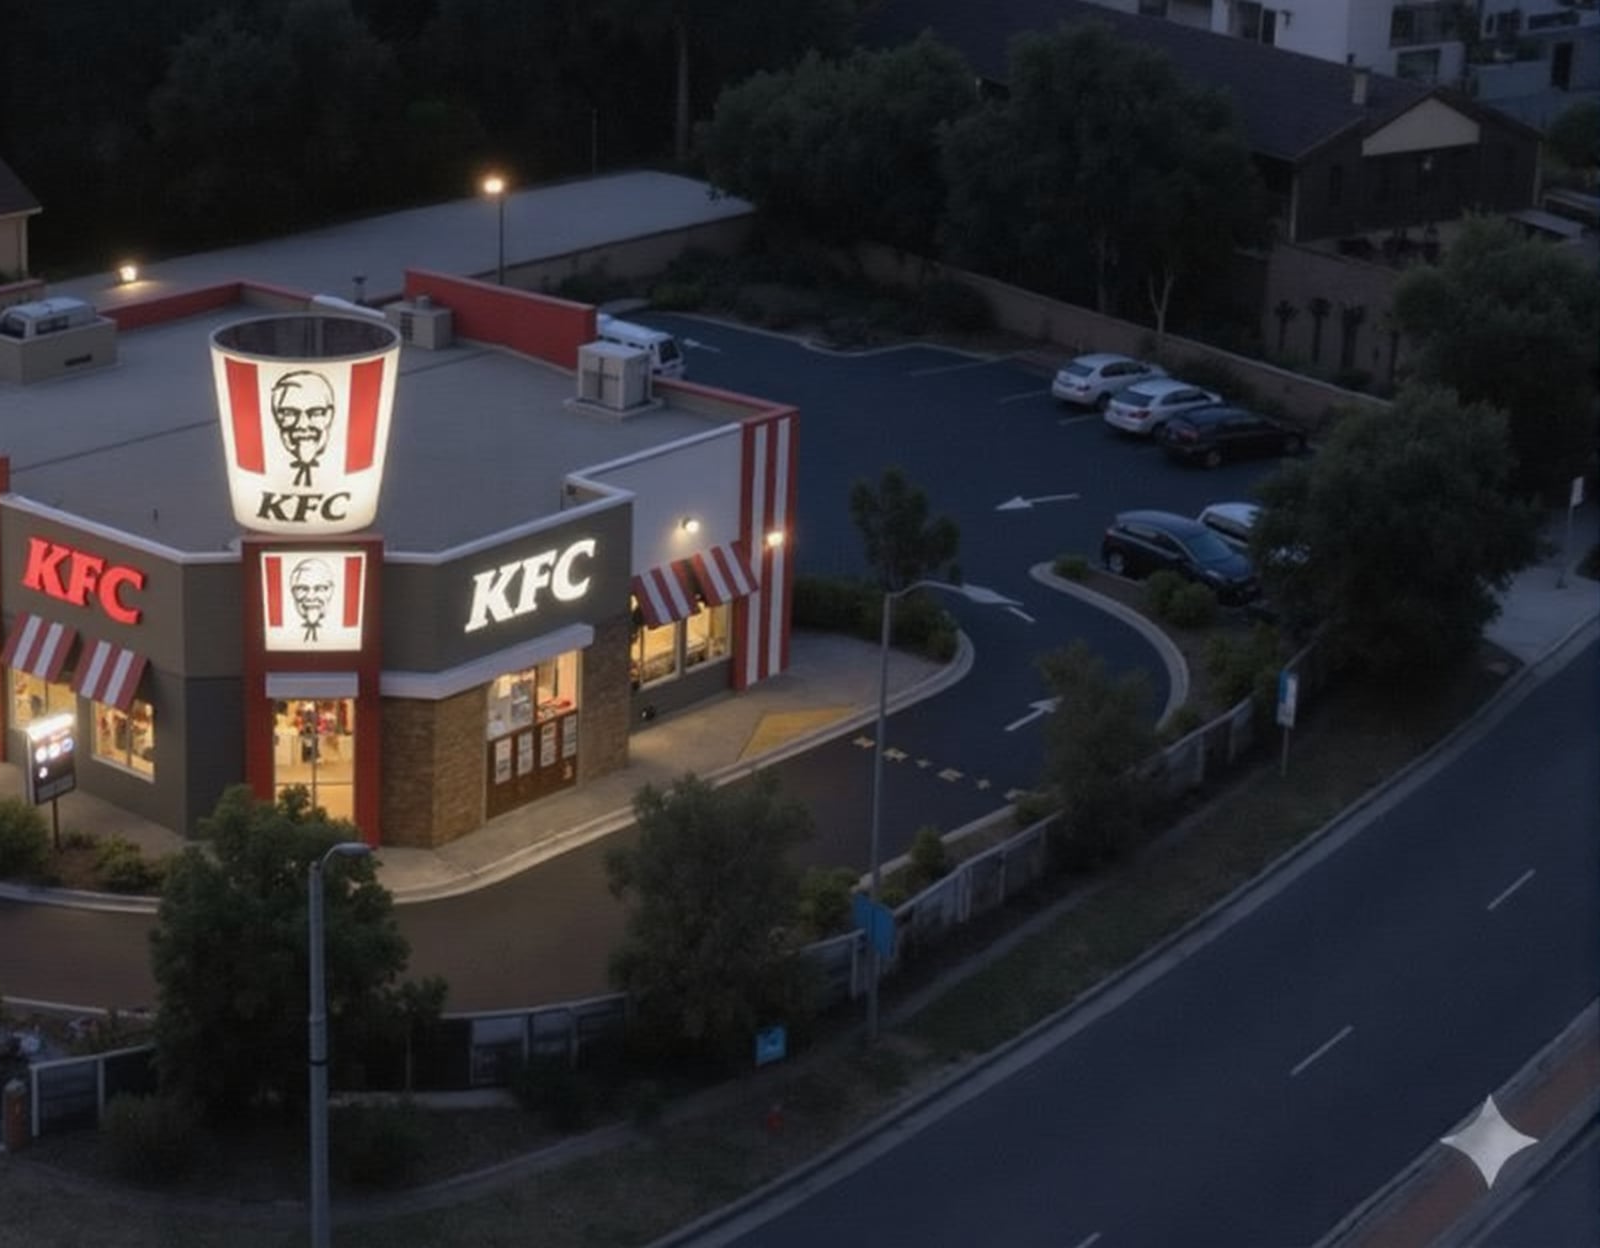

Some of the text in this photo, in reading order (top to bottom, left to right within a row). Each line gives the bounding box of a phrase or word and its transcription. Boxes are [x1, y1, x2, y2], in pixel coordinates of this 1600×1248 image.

[256, 491, 351, 523] KFC
[22, 537, 144, 625] KFC
[464, 538, 595, 634] KFC
